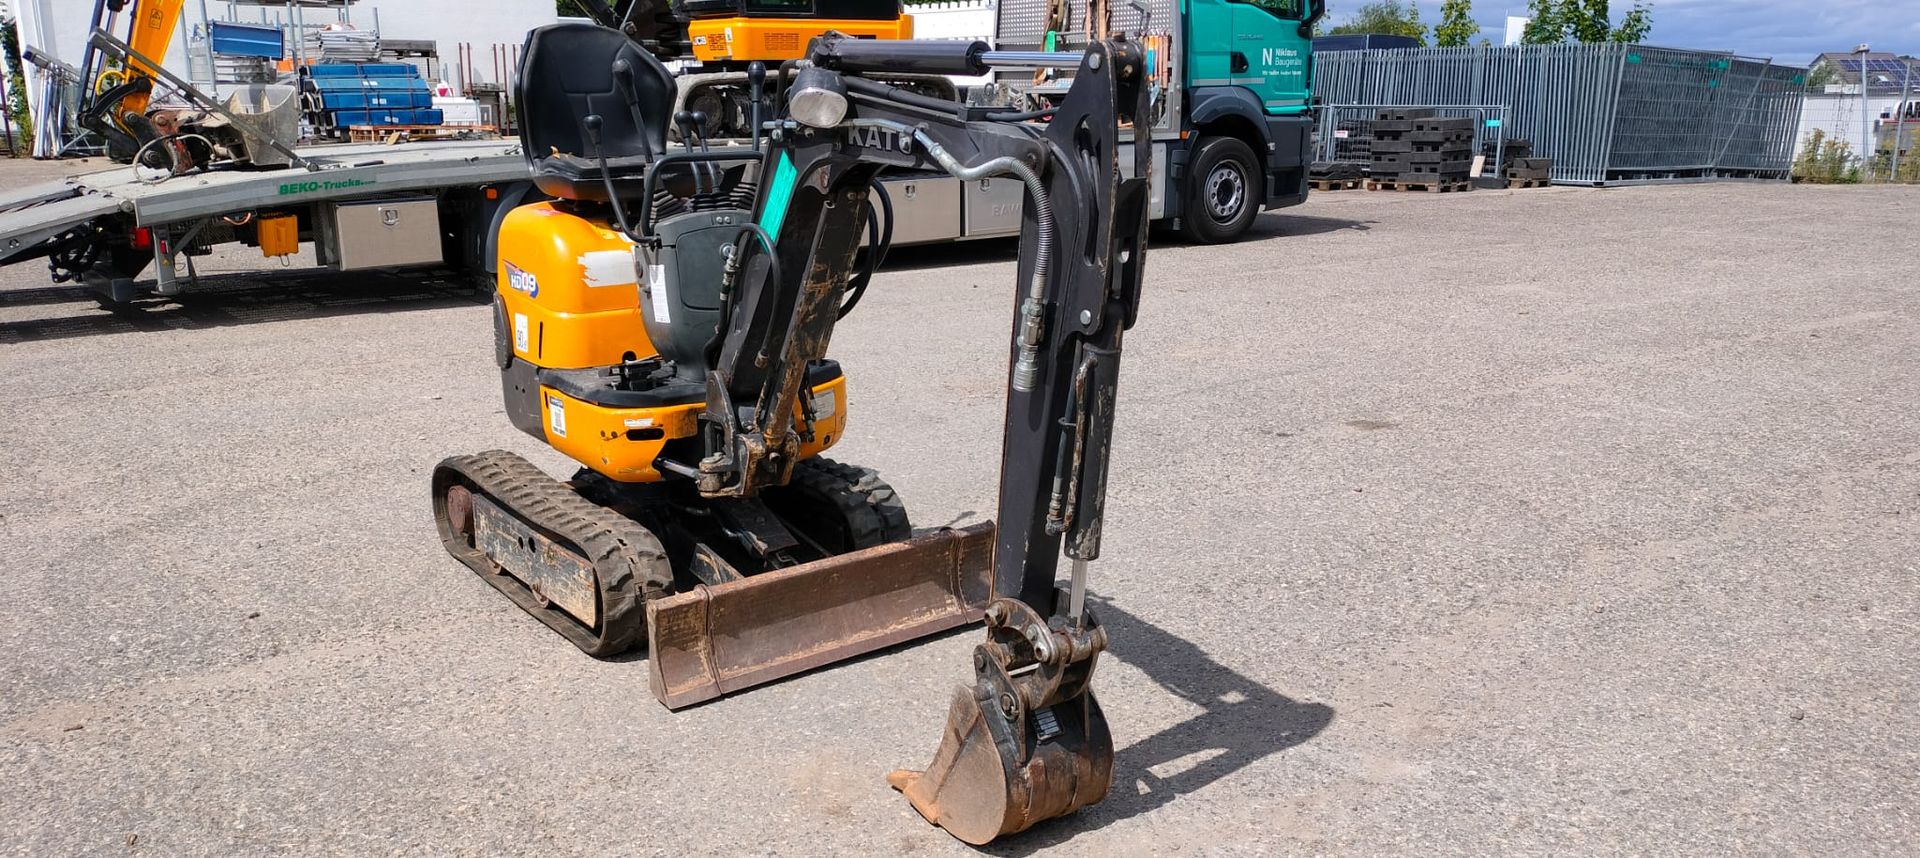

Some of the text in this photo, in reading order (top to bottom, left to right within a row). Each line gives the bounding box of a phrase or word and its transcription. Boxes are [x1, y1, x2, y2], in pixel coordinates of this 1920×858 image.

[1262, 48, 1273, 66] N
[1275, 48, 1297, 57] Niklaus
[511, 272, 536, 292] HD09
